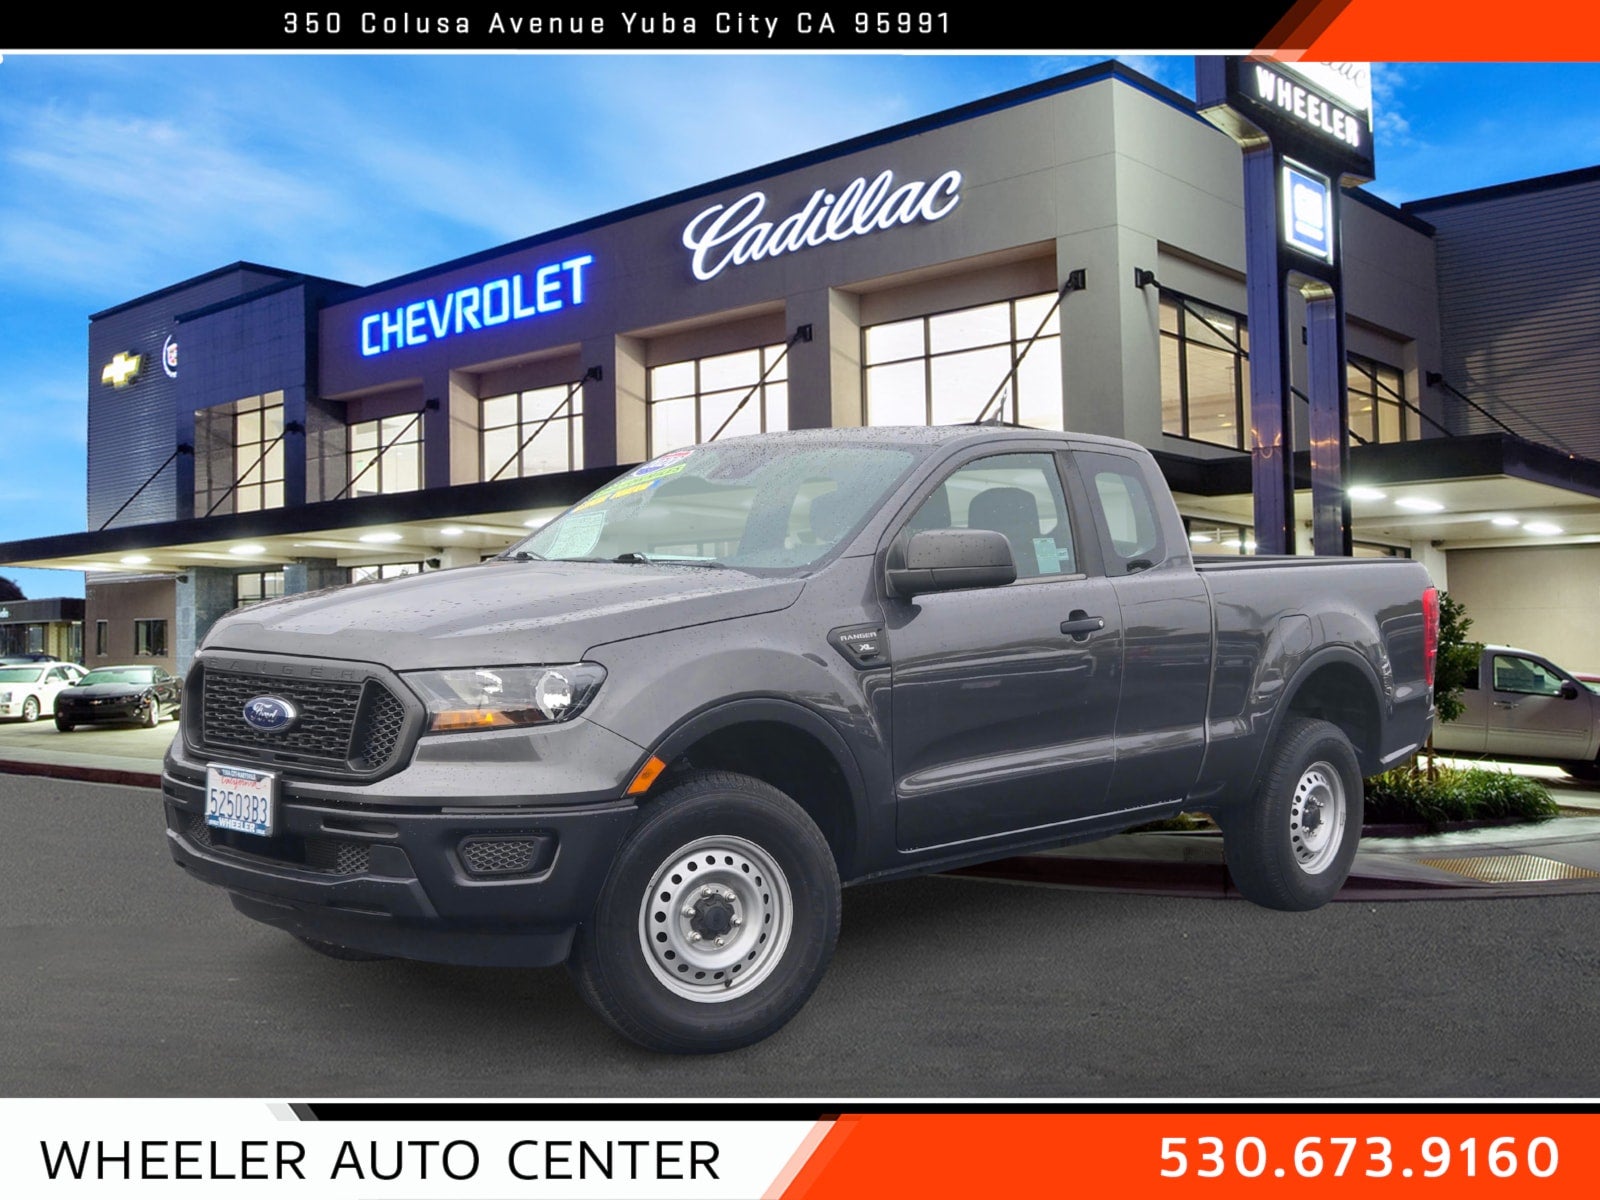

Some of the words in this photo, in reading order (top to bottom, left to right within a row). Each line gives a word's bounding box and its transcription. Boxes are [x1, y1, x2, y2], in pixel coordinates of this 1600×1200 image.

[1255, 65, 1360, 147] WHEELER
[682, 169, 962, 281] Cadillac
[361, 254, 594, 356] CHEVROLET
[840, 631, 877, 641] RANGER
[859, 643, 875, 651] XL
[252, 702, 278, 719] Ford
[210, 788, 268, 824] 52503B3
[219, 816, 256, 833] WHEELER
